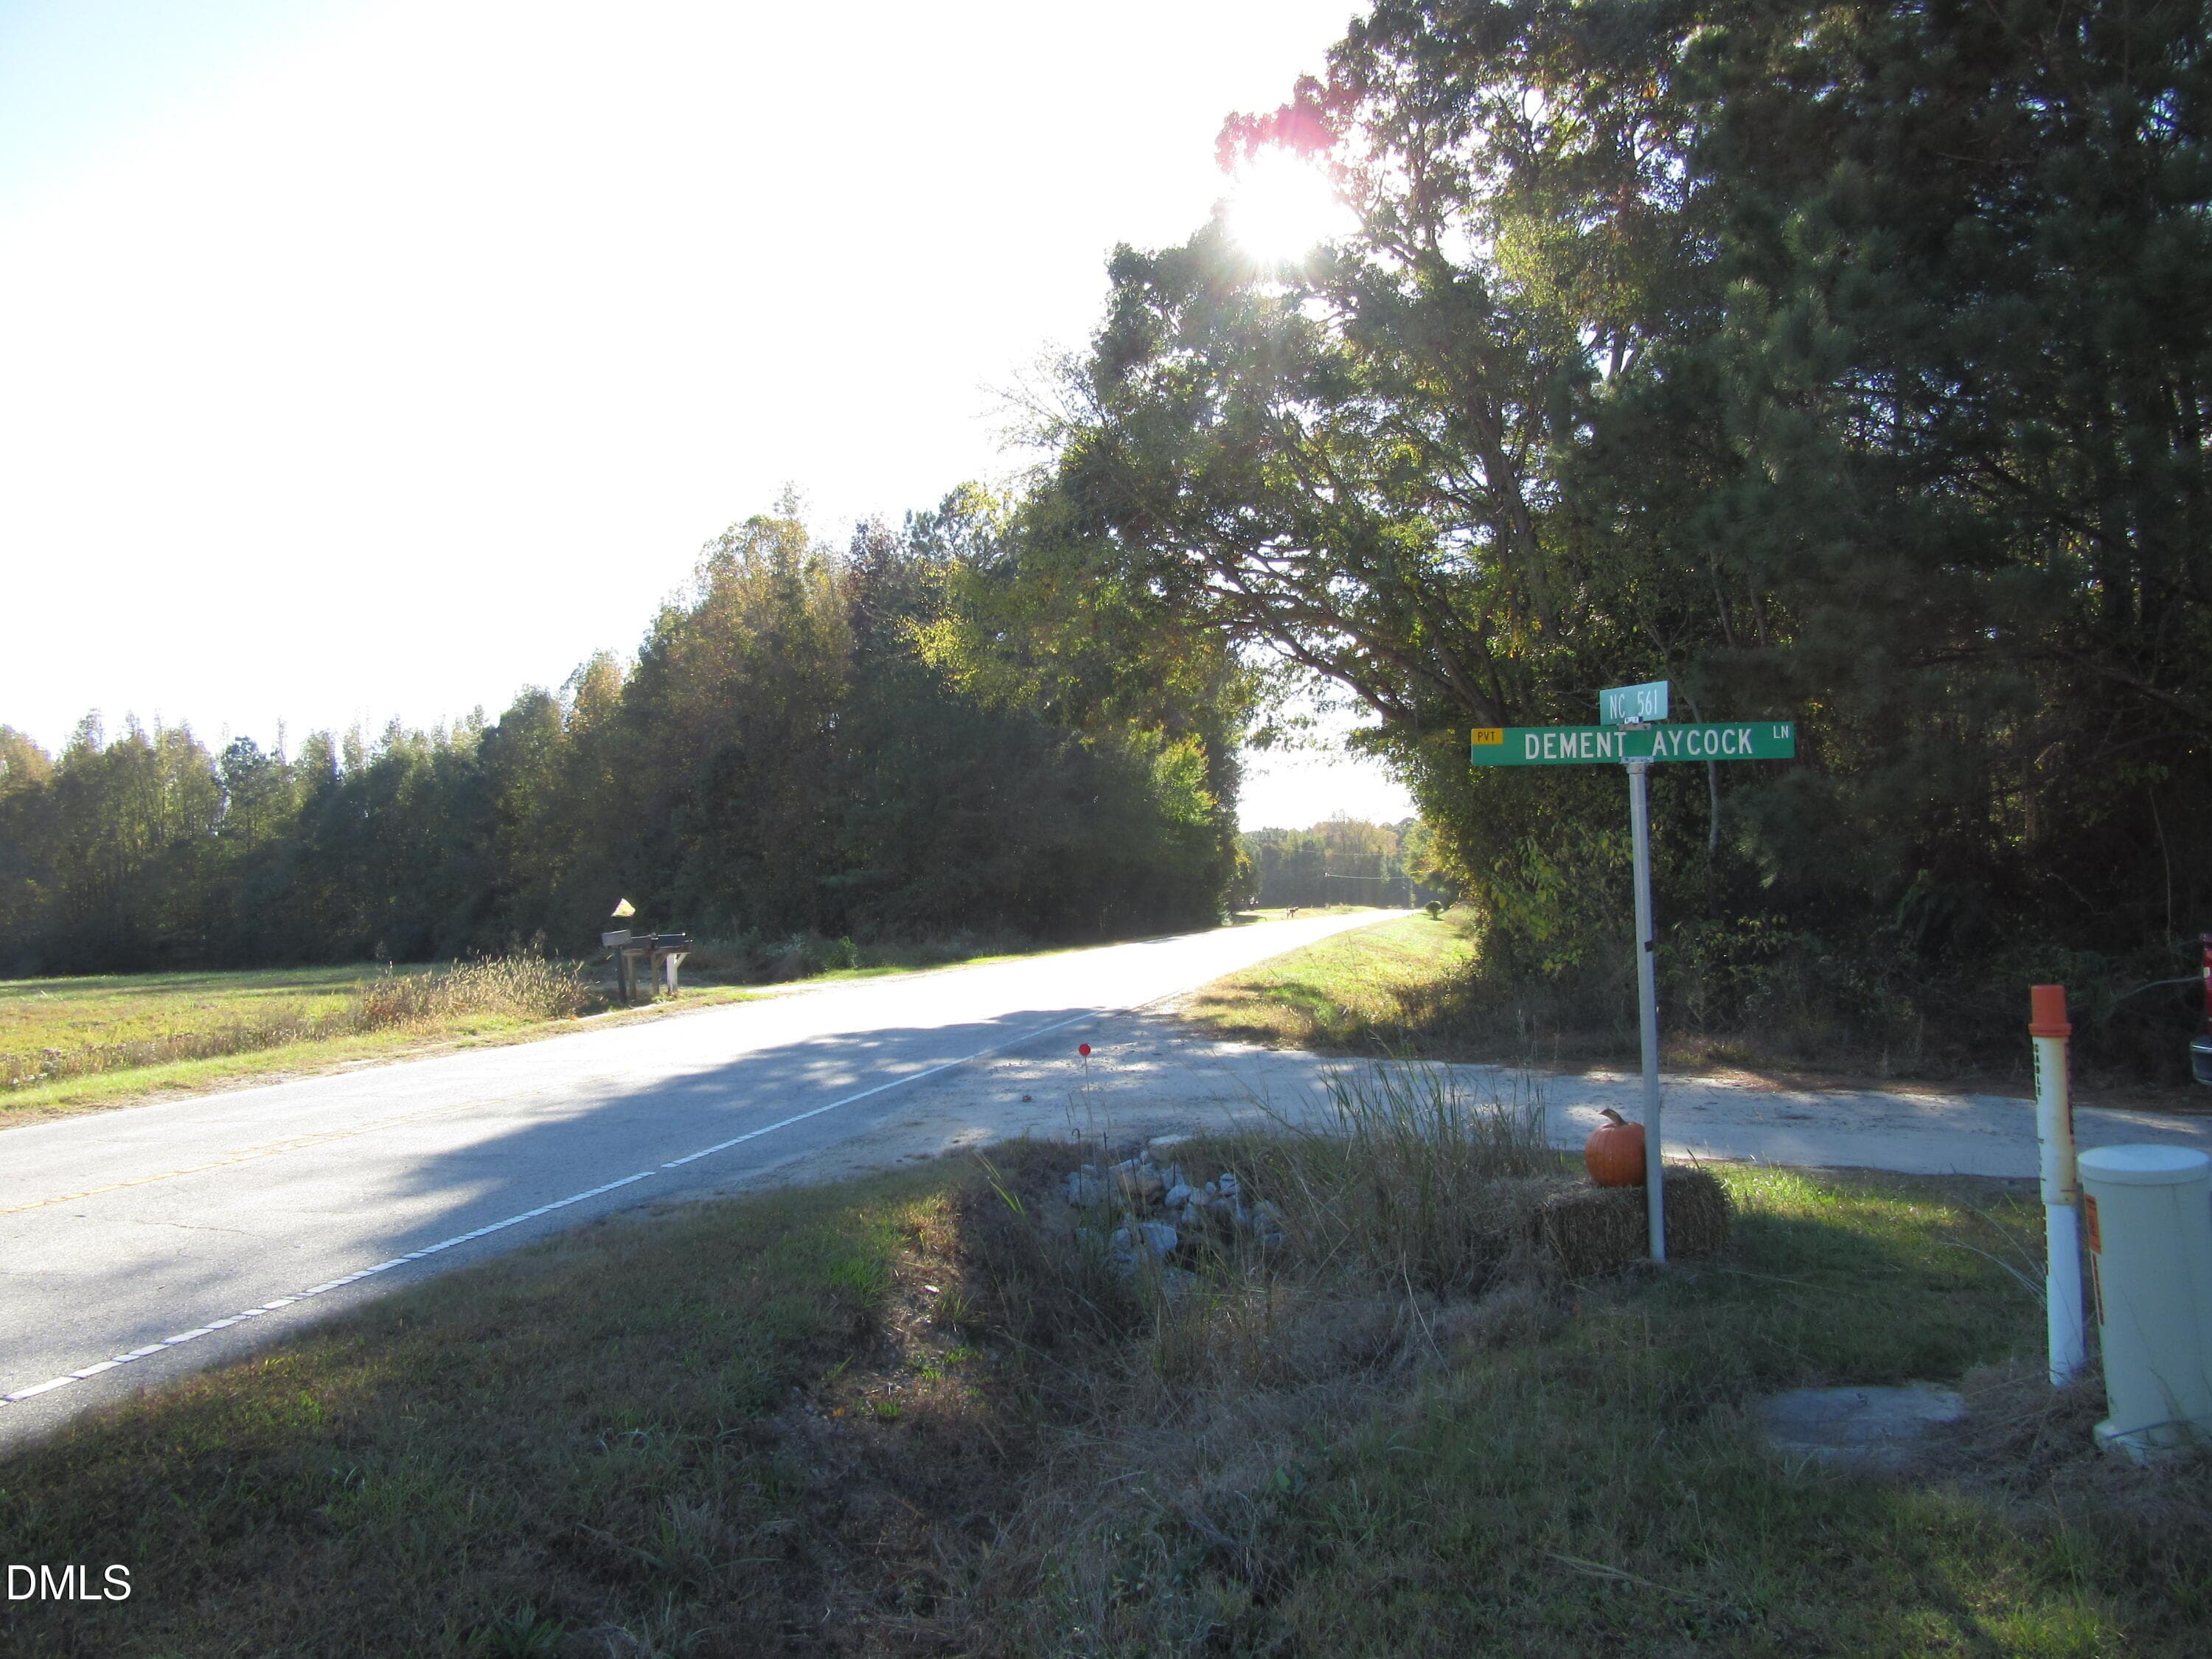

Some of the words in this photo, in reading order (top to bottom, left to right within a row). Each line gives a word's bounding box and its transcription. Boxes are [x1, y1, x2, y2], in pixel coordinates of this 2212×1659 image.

[1610, 694, 1625, 720] NC
[1638, 689, 1658, 716] 561
[1477, 731, 1495, 742] PVT
[1525, 731, 1627, 759] DEMENT
[1652, 728, 1753, 756] AYCOCK
[1773, 726, 1789, 739] LN
